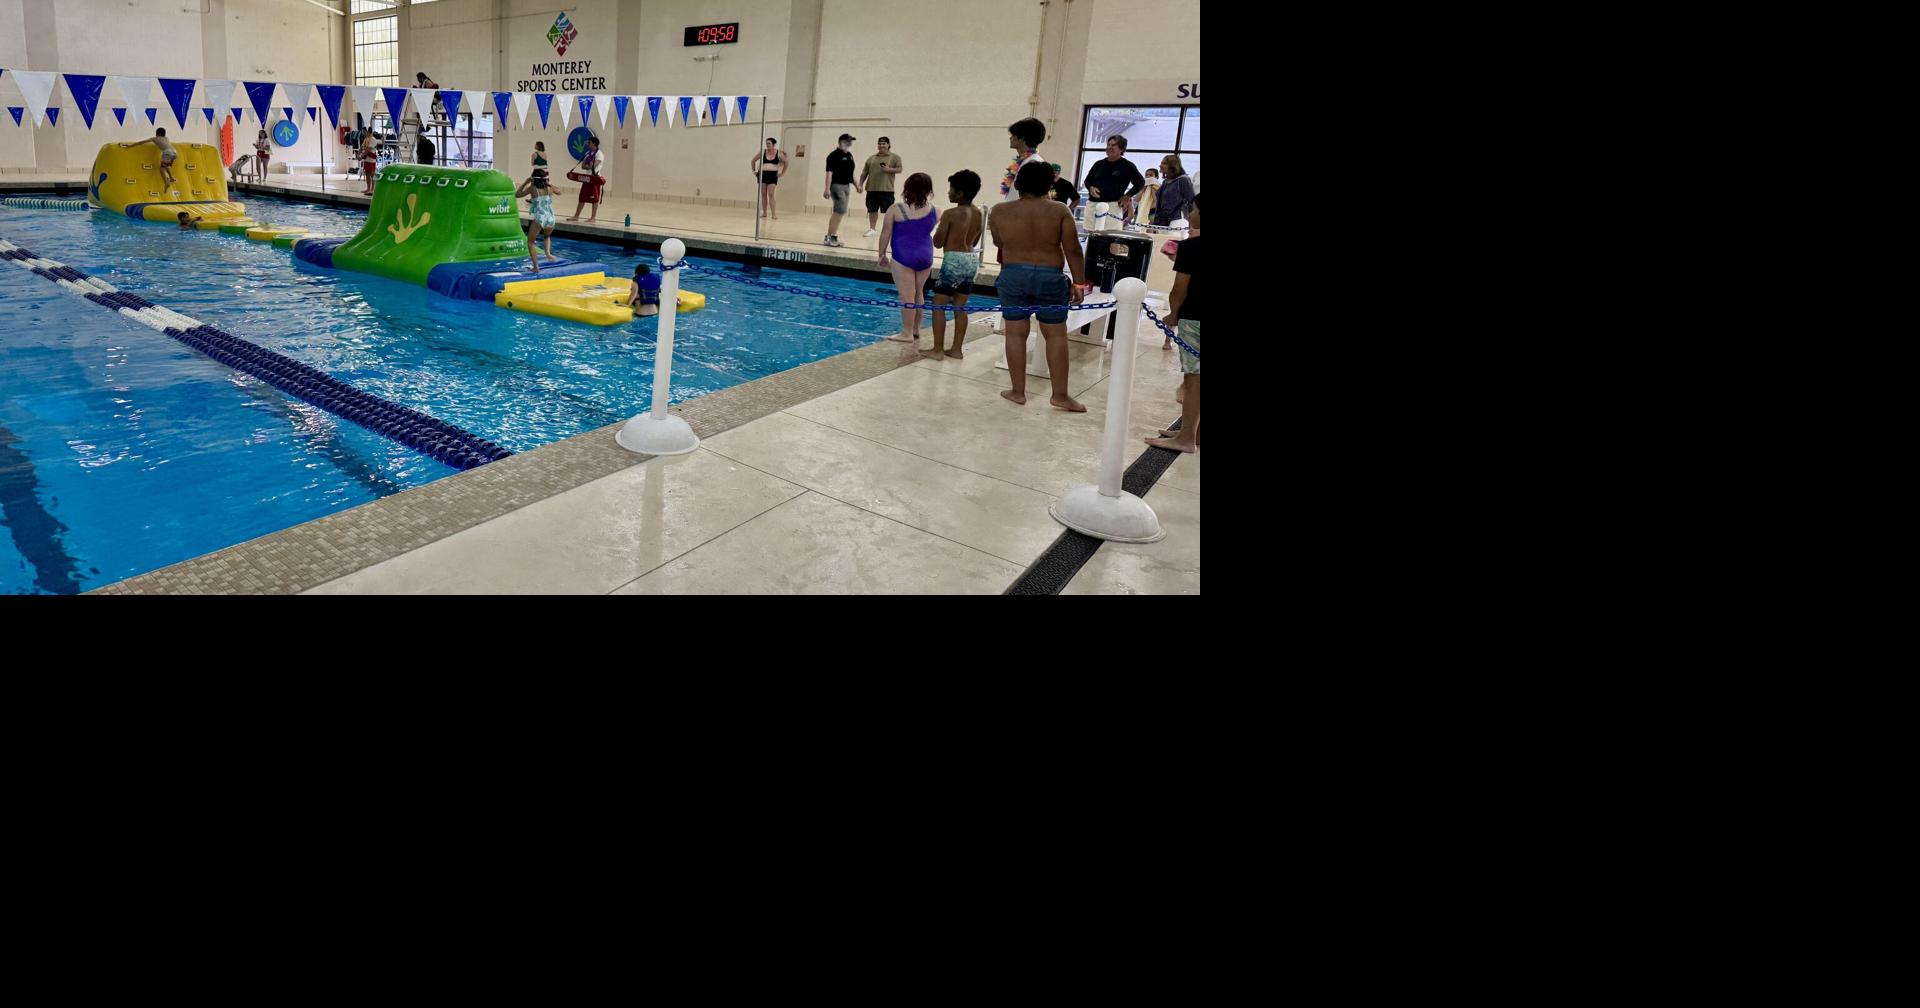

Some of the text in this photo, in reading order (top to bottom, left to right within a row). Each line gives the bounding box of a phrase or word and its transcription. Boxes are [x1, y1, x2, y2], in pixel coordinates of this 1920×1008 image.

[532, 60, 592, 76] MONTEREY
[517, 77, 607, 92] SPORTS CENTER
[489, 204, 510, 214] wibit
